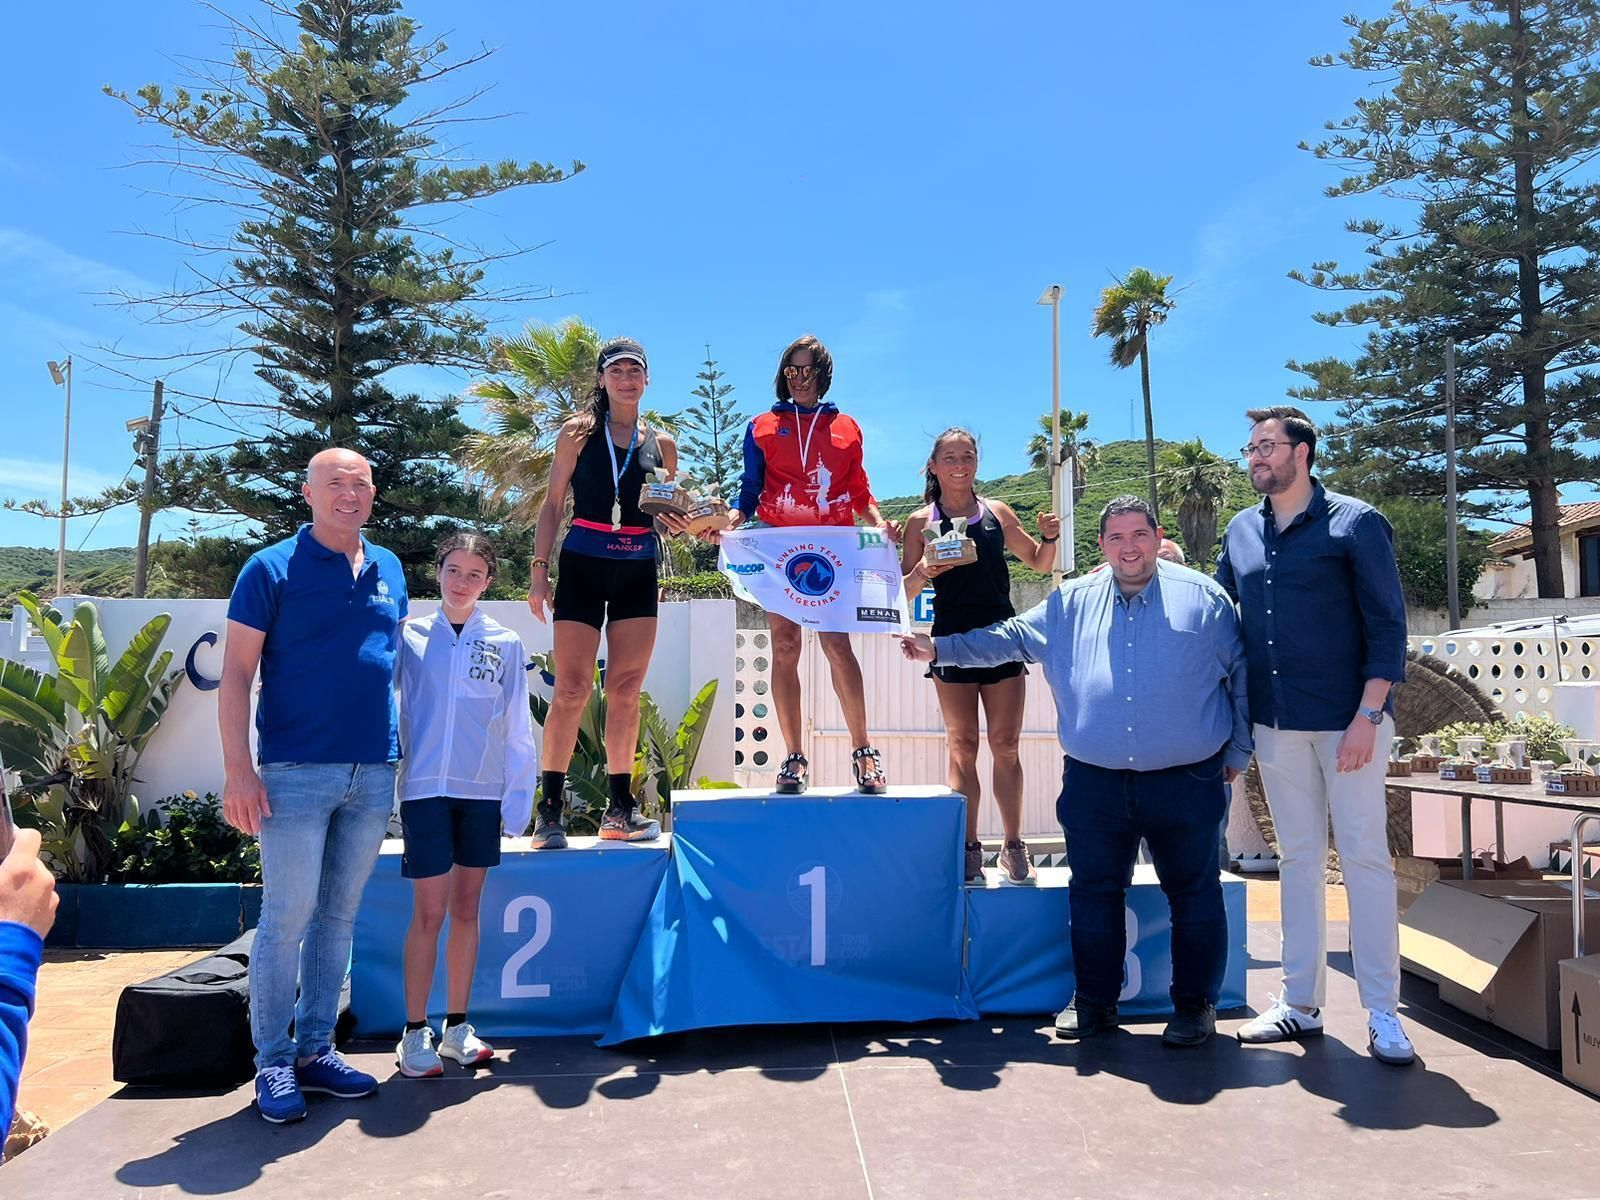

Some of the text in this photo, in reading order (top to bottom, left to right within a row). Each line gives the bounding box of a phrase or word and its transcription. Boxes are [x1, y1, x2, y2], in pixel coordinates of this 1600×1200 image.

[775, 543, 843, 570] RUNNING TEAM
[784, 587, 840, 607] ALGECIRAS
[861, 609, 897, 618] MENAL
[469, 666, 495, 682] on
[799, 866, 825, 965] 1
[501, 895, 552, 998] 2
